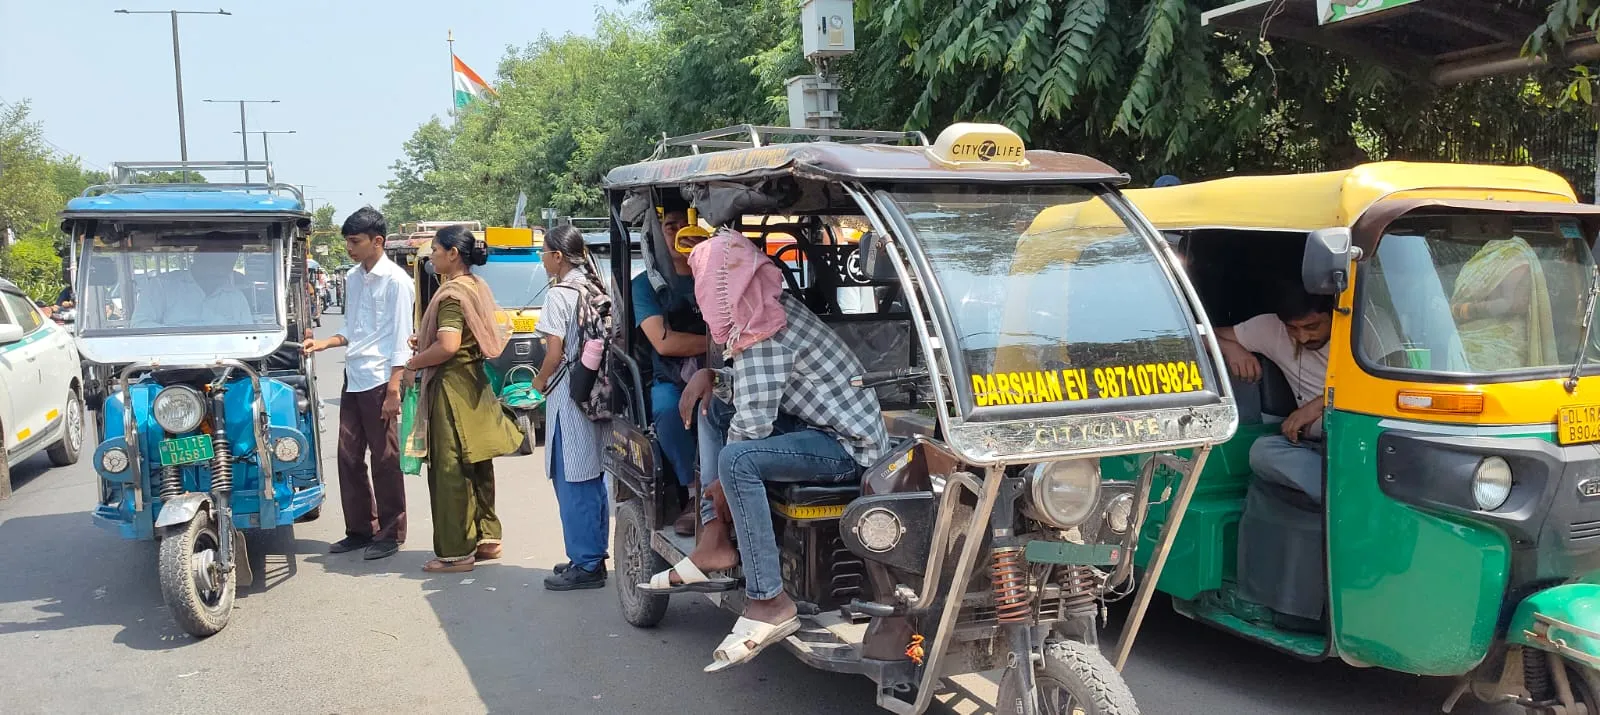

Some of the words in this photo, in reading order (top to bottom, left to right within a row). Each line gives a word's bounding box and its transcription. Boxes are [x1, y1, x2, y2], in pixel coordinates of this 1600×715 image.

[952, 144, 979, 154] CITY
[996, 145, 1021, 156] LIFE
[971, 370, 1062, 406] DARSHAN
[1062, 368, 1089, 400] EV
[1094, 360, 1203, 398] 9871079824
[1036, 424, 1087, 445] CITY
[1111, 417, 1161, 439] LIFE
